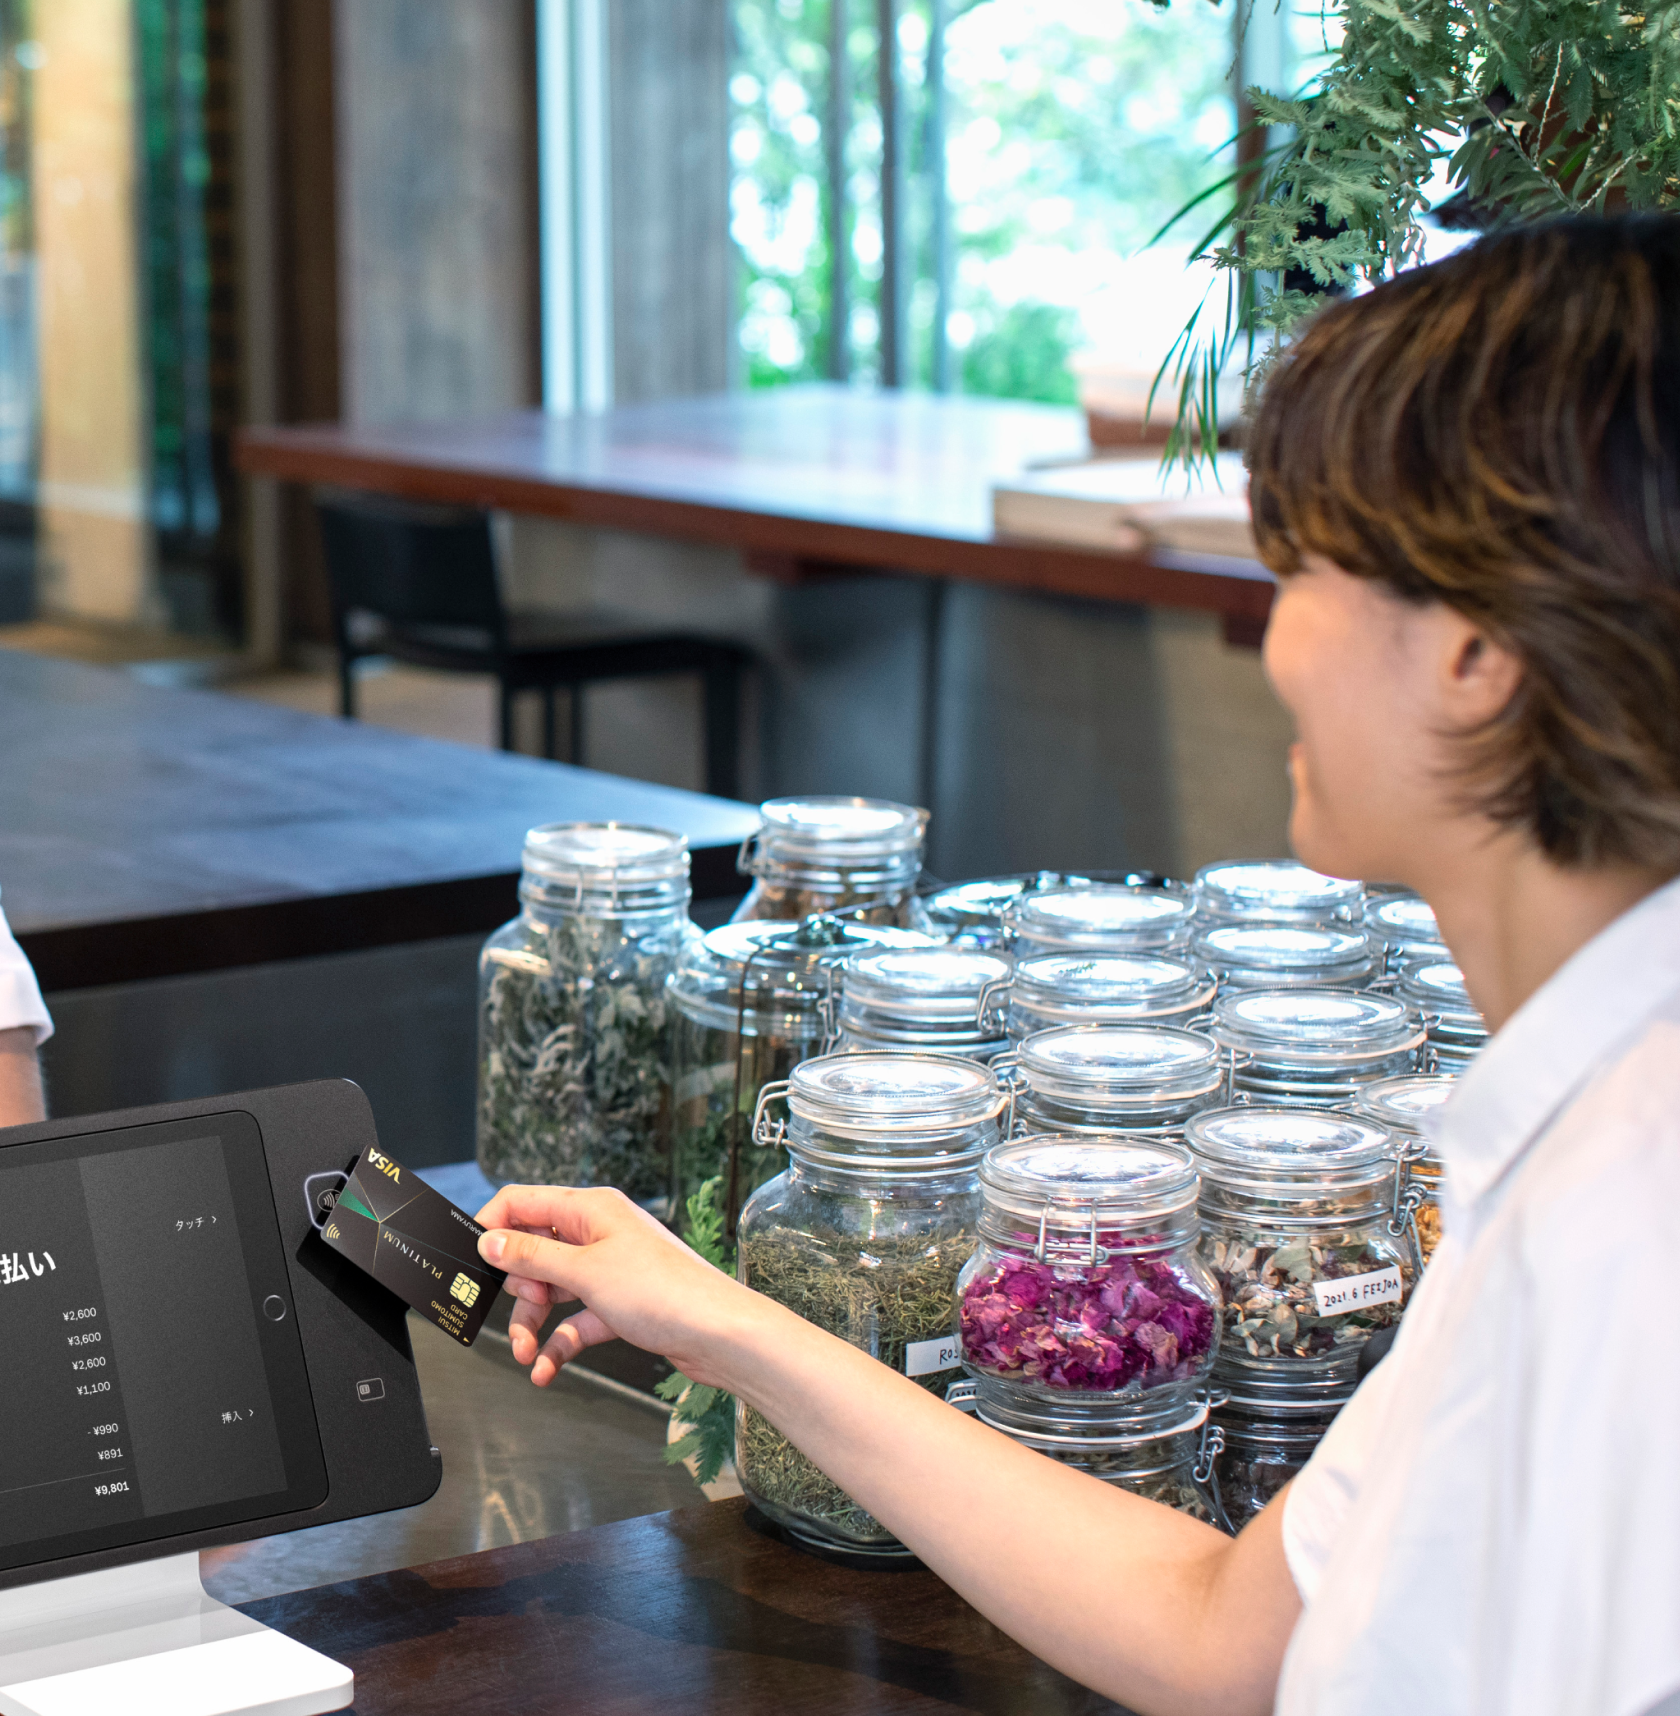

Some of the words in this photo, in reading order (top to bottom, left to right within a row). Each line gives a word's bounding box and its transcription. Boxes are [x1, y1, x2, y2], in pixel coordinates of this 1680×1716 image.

[367, 1147, 400, 1185] VISA
[175, 1216, 205, 1232] タッチ
[383, 1230, 443, 1280] PLATINUM
[1362, 1278, 1399, 1299] FEIJOA
[62, 1307, 97, 1321] ¥2,600
[431, 1300, 465, 1328] SUMITOMO
[450, 1304, 468, 1320] CARD
[438, 1316, 460, 1336] MITSUI
[67, 1332, 101, 1346] ¥3,600
[71, 1356, 106, 1370] ¥2,600
[76, 1381, 111, 1395] ¥1,100
[221, 1410, 243, 1424] 挿入
[97, 1447, 123, 1460] ¥891
[94, 1481, 130, 1496] ¥9,801
